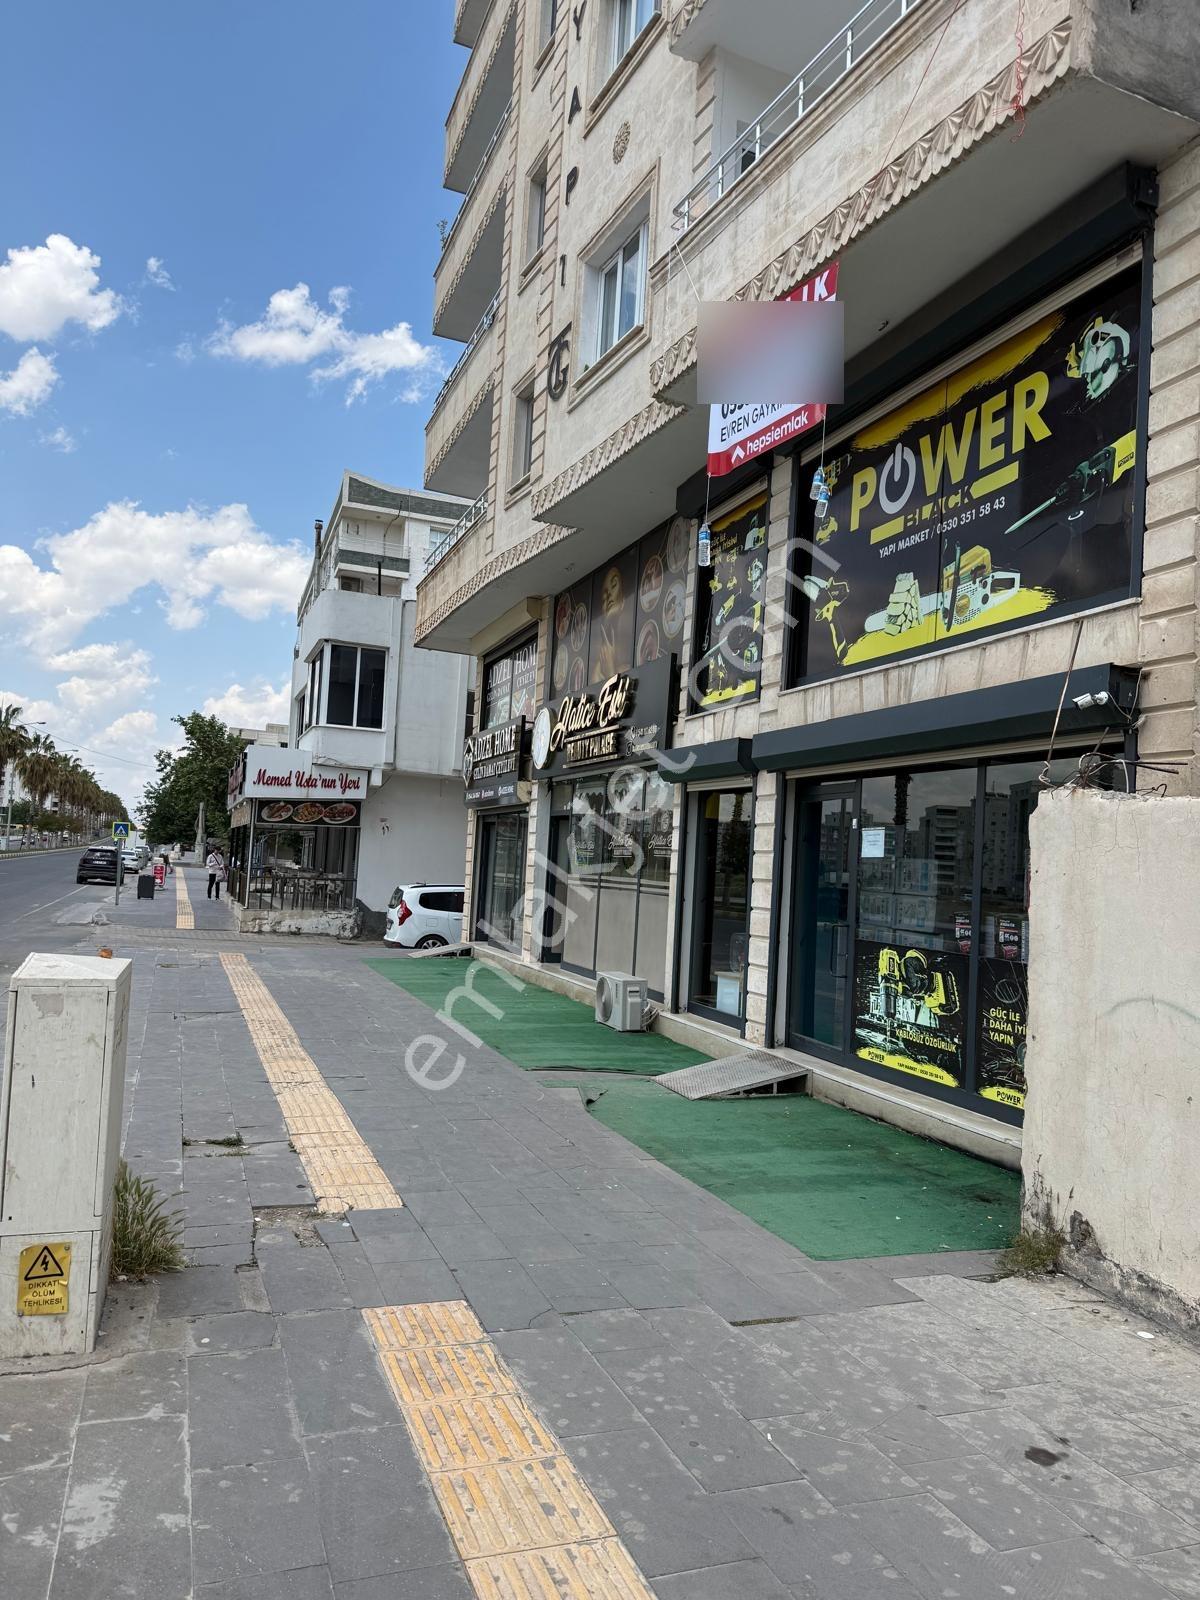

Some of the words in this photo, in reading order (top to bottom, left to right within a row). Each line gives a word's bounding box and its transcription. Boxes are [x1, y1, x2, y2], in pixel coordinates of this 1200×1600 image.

[720, 412, 750, 442] EVREN
[746, 410, 809, 456] hepsiemlak
[850, 370, 1053, 532] POWER
[879, 543, 896, 559] YAPI
[897, 528, 930, 552] MARKET
[936, 517, 958, 534] 0530
[960, 509, 976, 525] 351
[979, 502, 991, 517] 58
[993, 496, 1006, 510] 43
[515, 642, 537, 675] HOM
[473, 733, 493, 762] ADZEL
[494, 724, 517, 756] HOME
[253, 768, 293, 787] Memed
[338, 773, 361, 795] Yeri
[989, 1006, 1008, 1020] GÜÇ
[1009, 1009, 1021, 1022] İLE
[989, 1020, 1013, 1032] DAHA
[989, 1031, 1014, 1045] YAPIN
[868, 1050, 885, 1062] POWER
[996, 1090, 1021, 1105] POWER
